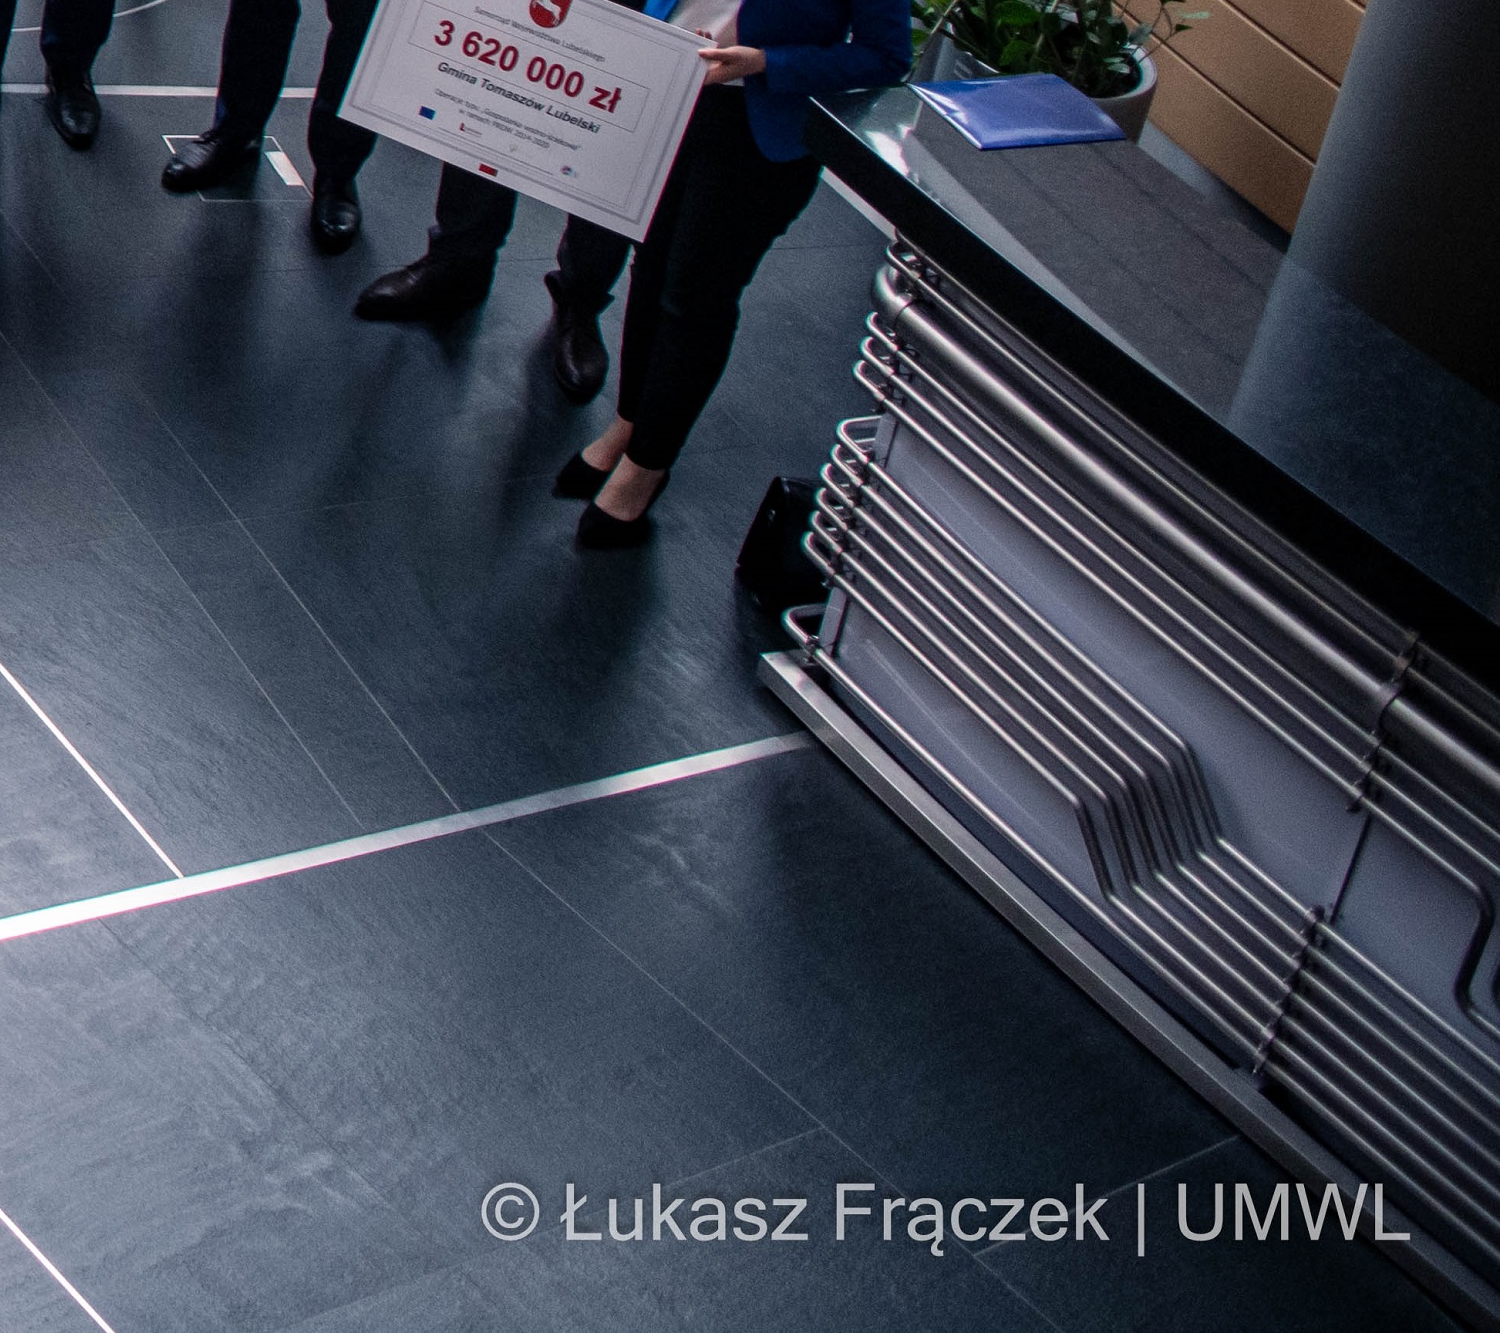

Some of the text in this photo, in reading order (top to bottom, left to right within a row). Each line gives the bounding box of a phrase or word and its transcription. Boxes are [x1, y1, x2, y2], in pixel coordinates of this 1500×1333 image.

[434, 20, 621, 113] 3 620 000 zł
[436, 60, 600, 134] Gmina Tomaszów Lubelski
